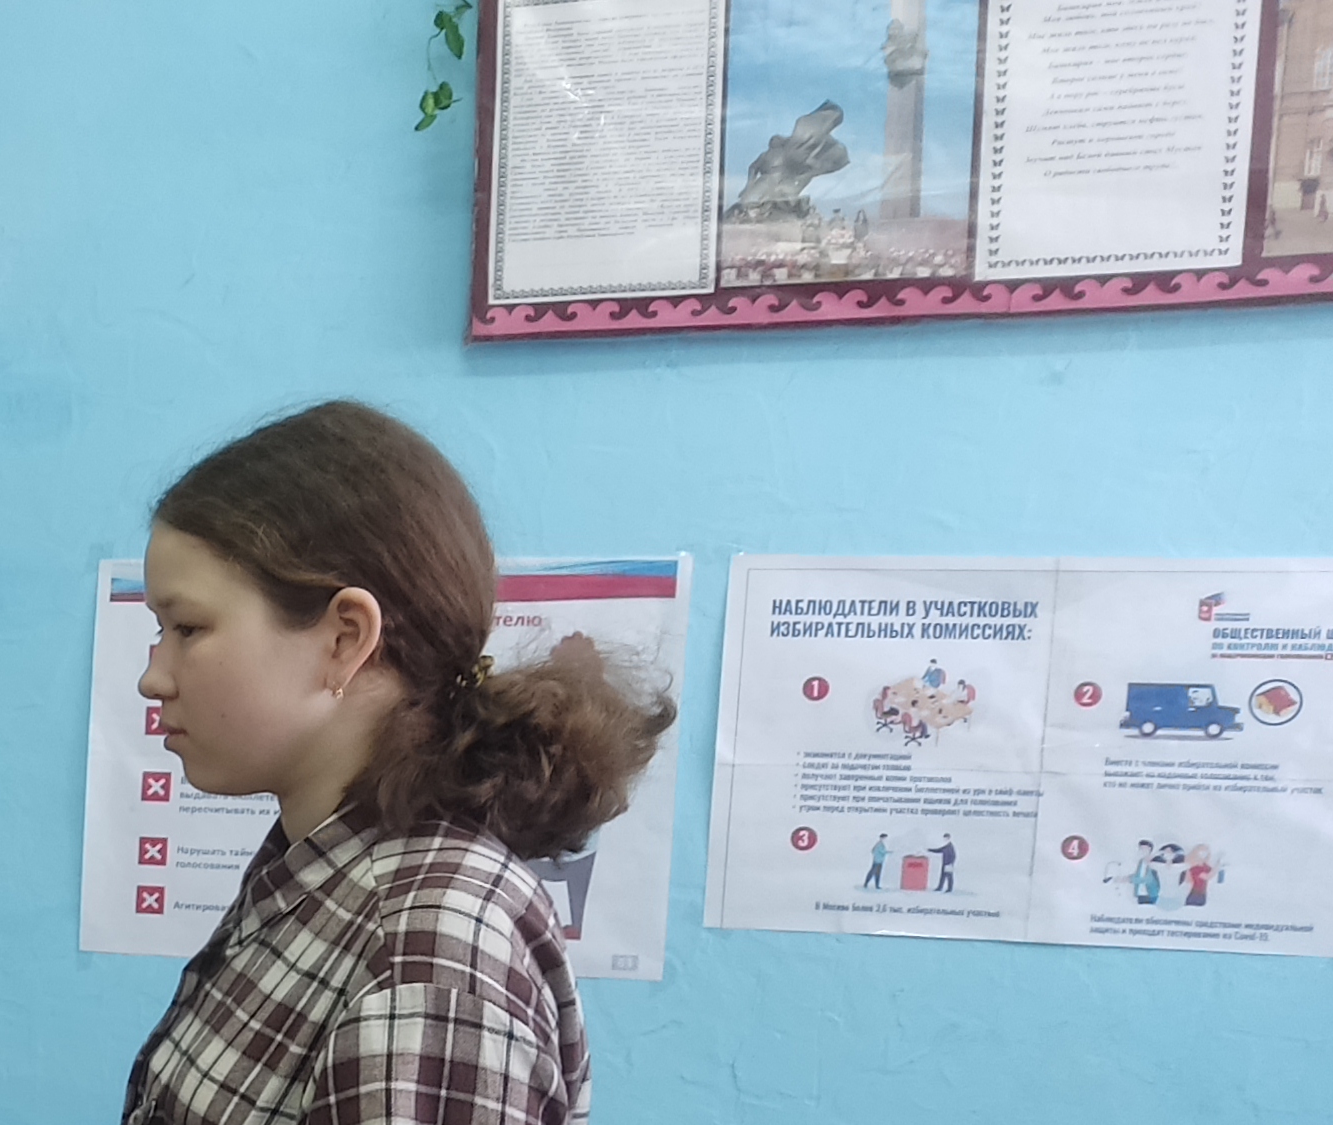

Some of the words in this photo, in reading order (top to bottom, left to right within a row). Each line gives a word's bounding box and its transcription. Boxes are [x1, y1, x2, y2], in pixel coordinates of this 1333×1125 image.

[771, 599, 900, 619] НАБЛЮДАТЕЛИ
[905, 600, 917, 617] В
[921, 600, 1039, 619] УЧАСТКОВЫХ
[495, 613, 542, 627] телю
[770, 621, 915, 639] ИЗБИРАТЕЛЬНЫХ
[920, 623, 1032, 641] КОМИССИЯХ:
[1212, 626, 1322, 640] ОБЩЕСТВЕННЫЙ
[810, 679, 819, 697] 1
[1081, 685, 1094, 704] 2
[797, 829, 810, 849] 3
[1067, 838, 1081, 858] 4
